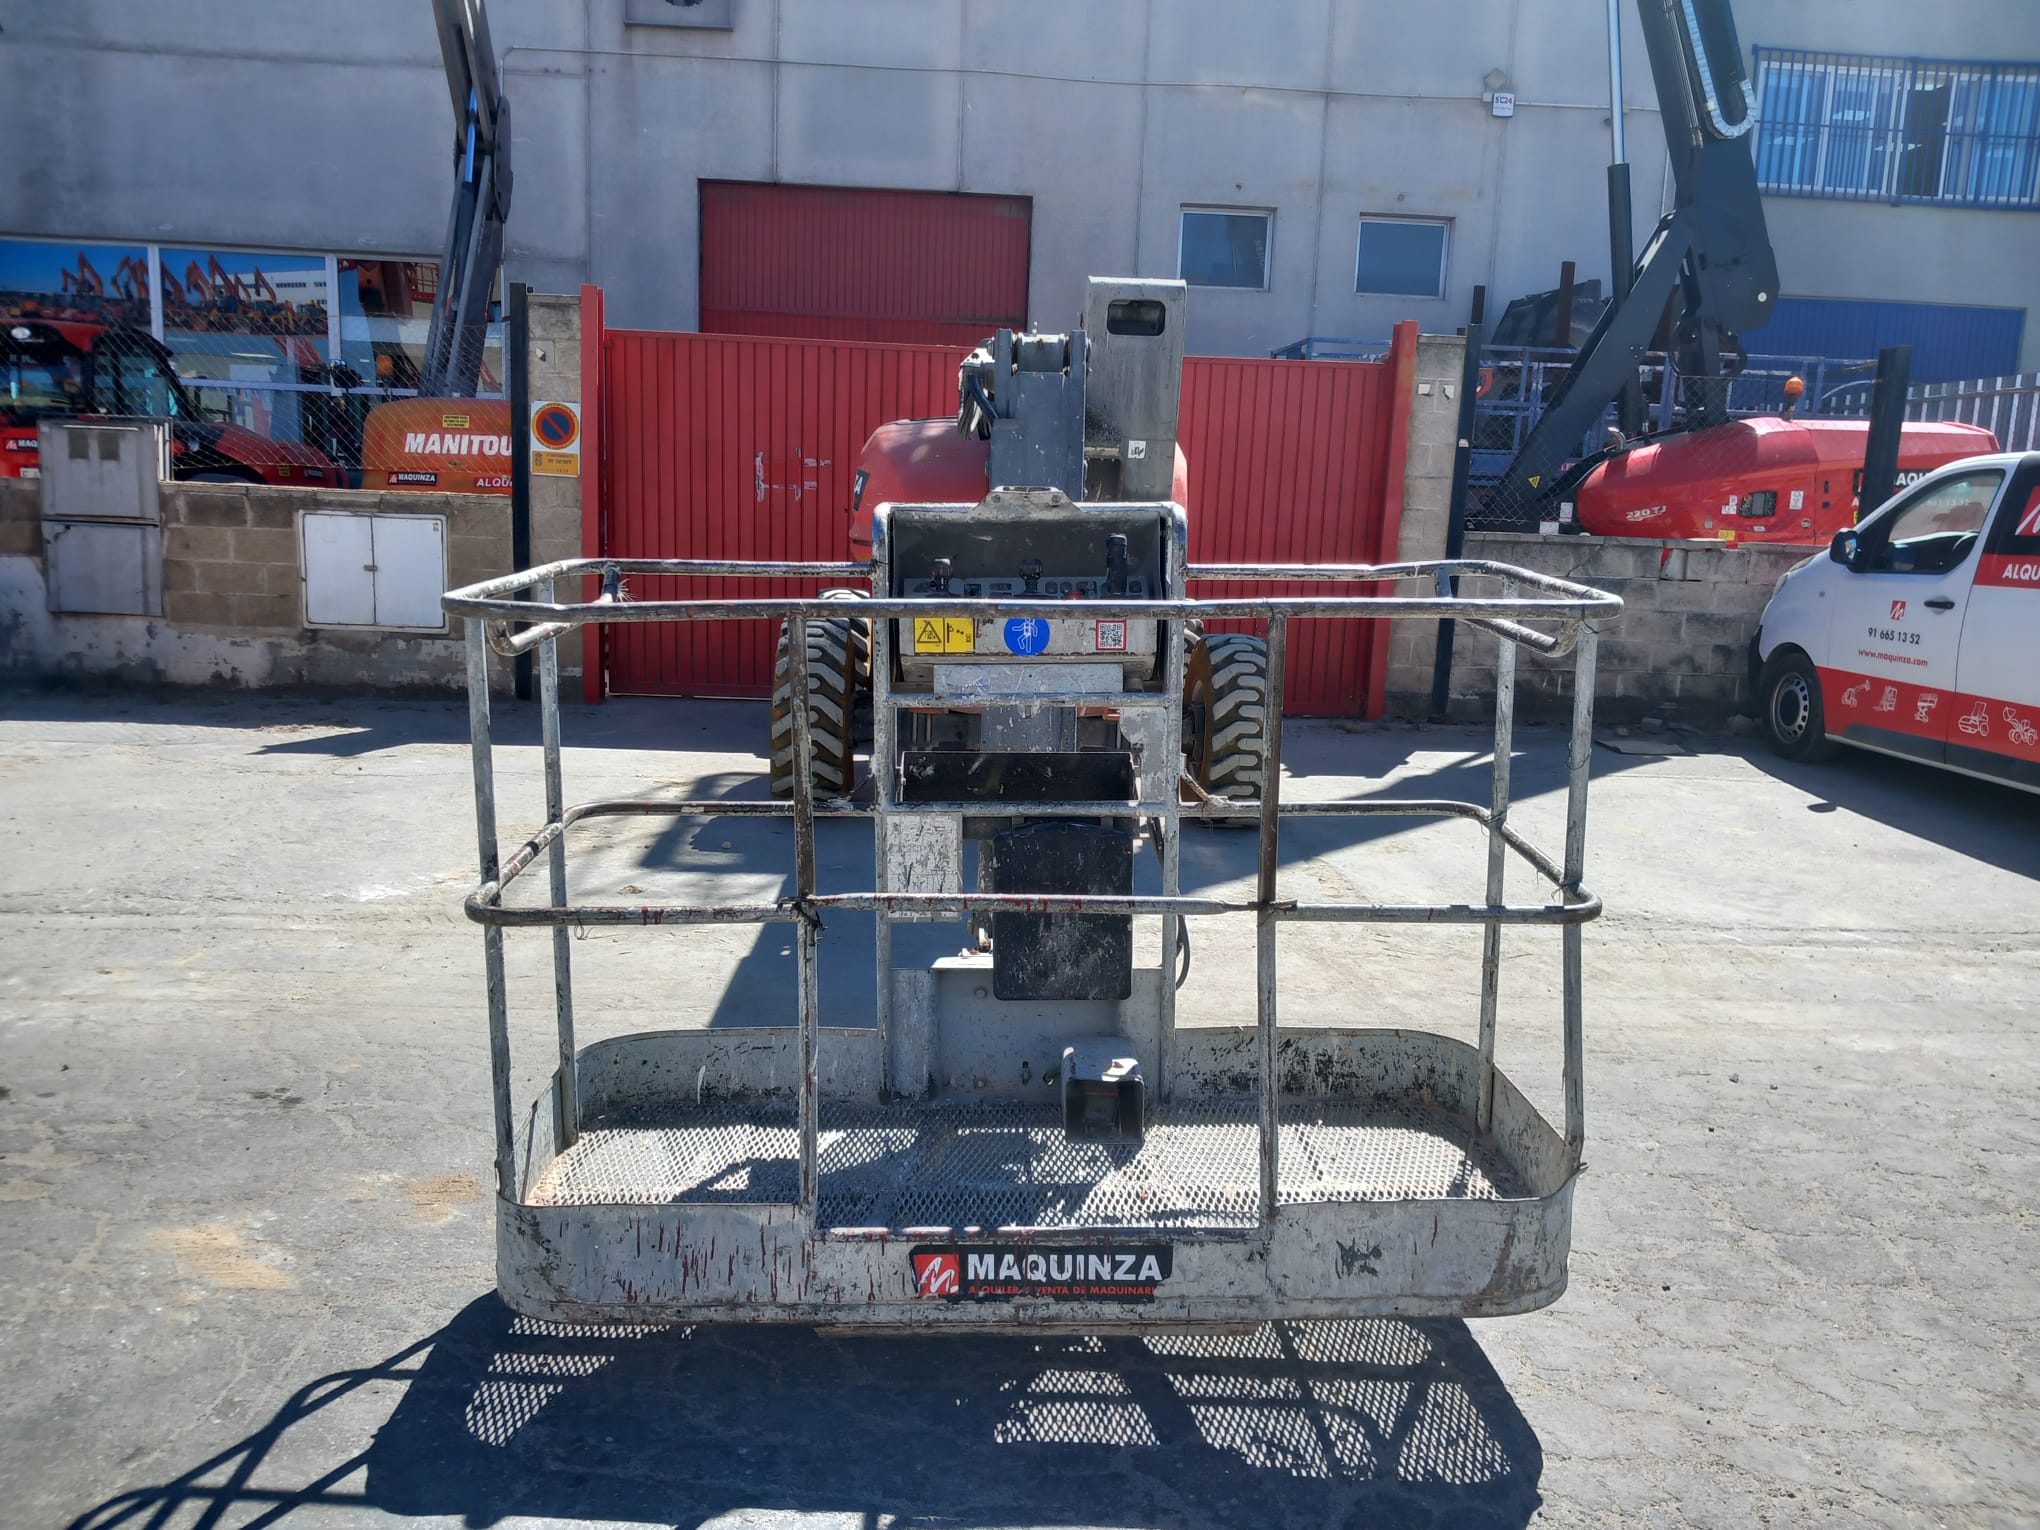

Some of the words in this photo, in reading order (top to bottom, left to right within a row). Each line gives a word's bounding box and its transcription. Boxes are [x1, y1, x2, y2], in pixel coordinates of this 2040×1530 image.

[404, 432, 512, 456] MANITOU
[398, 472, 436, 482] MAQUINZA
[1868, 627, 1877, 638] 91
[1879, 629, 1895, 641] 665
[1898, 631, 1907, 643] 13
[1909, 633, 1921, 645] 52
[1858, 649, 1928, 667] www.maquinza.com
[967, 1253, 1162, 1282] MAQUINZA
